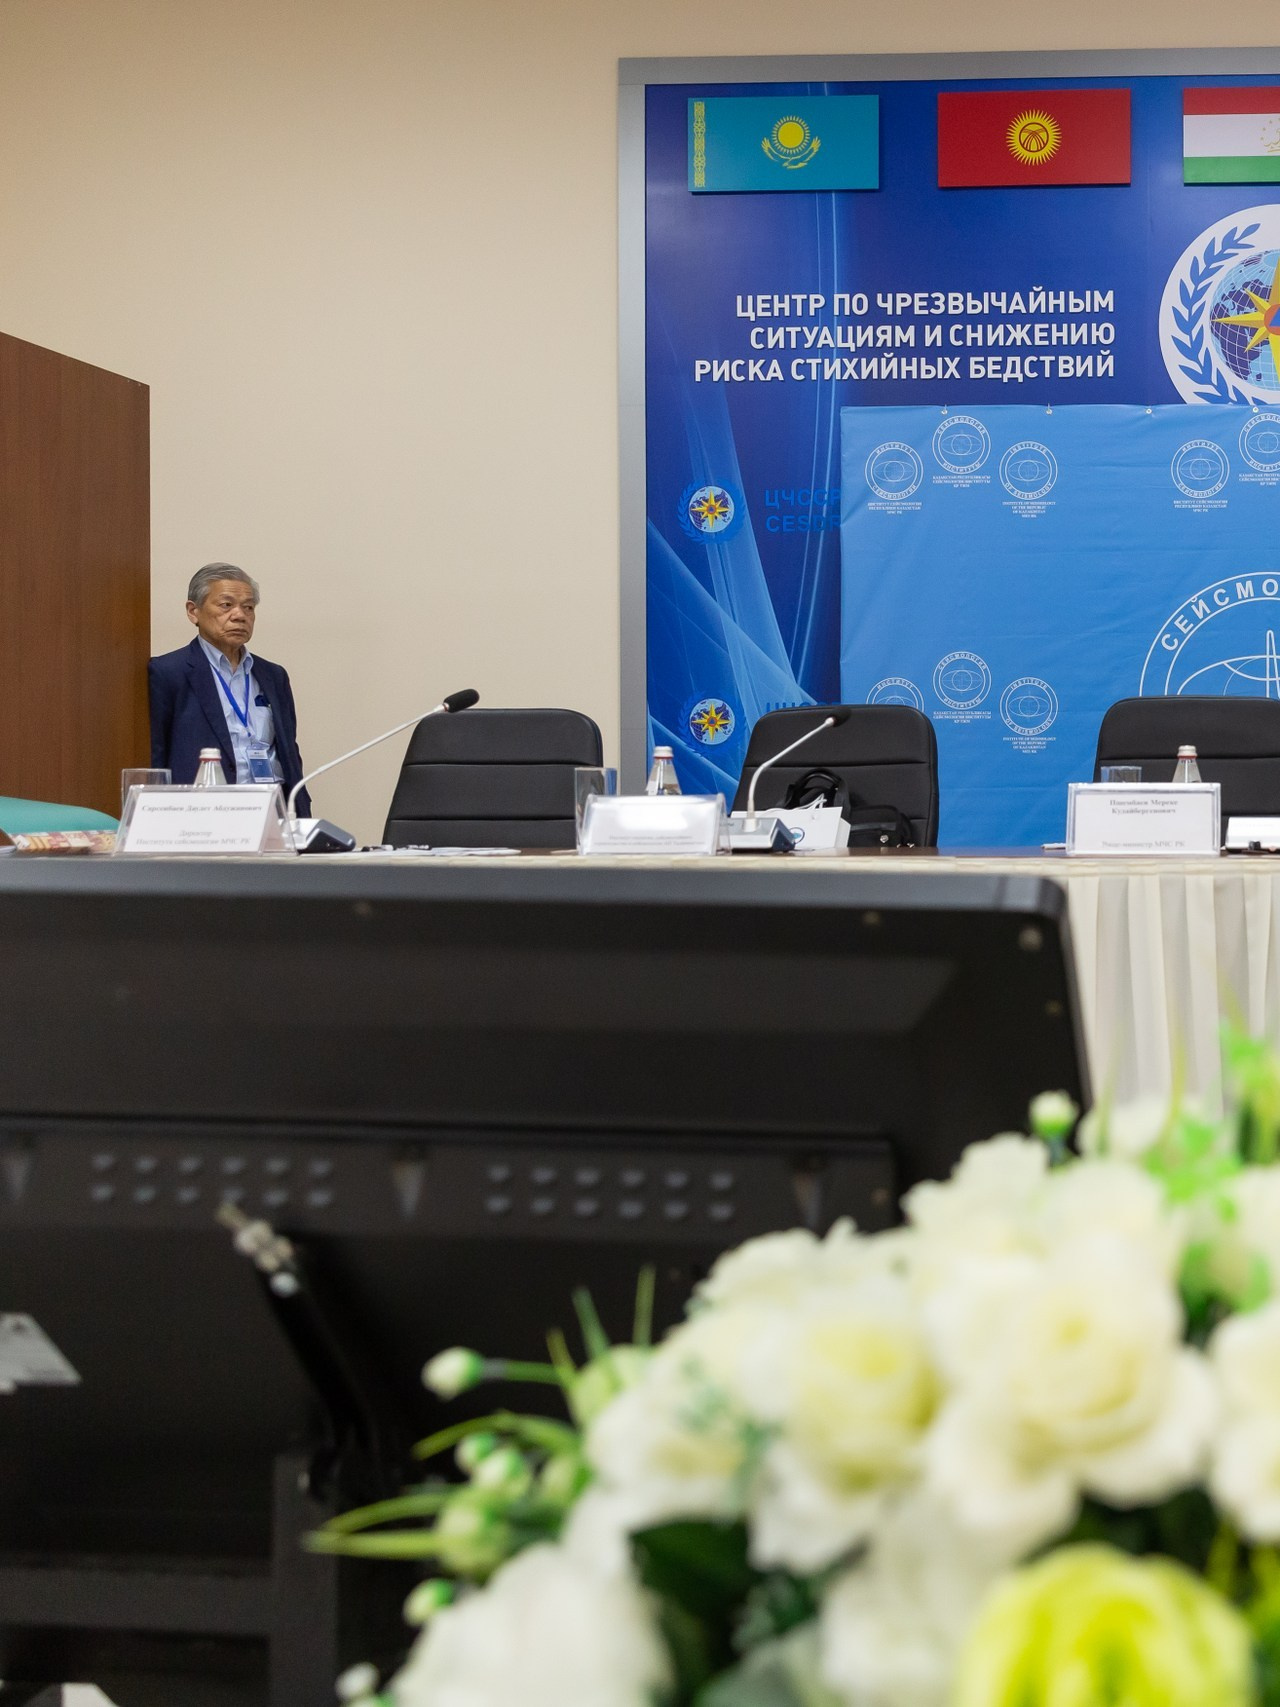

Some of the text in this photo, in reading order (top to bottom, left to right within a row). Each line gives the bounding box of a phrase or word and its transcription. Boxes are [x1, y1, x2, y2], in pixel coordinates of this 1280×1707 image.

[736, 286, 1115, 322] ЦЕНТР ПО ЧРЕЗВЫЧАЙНЫМ
[750, 322, 1115, 352] СИТУАЦИЯМ И СНИЖЕНИЮ
[694, 349, 1114, 384] РИСКА СТИХИЙНЫХ БЕДСТВИЙ
[765, 488, 841, 510] ЦЧССР
[766, 515, 841, 532] CESDR
